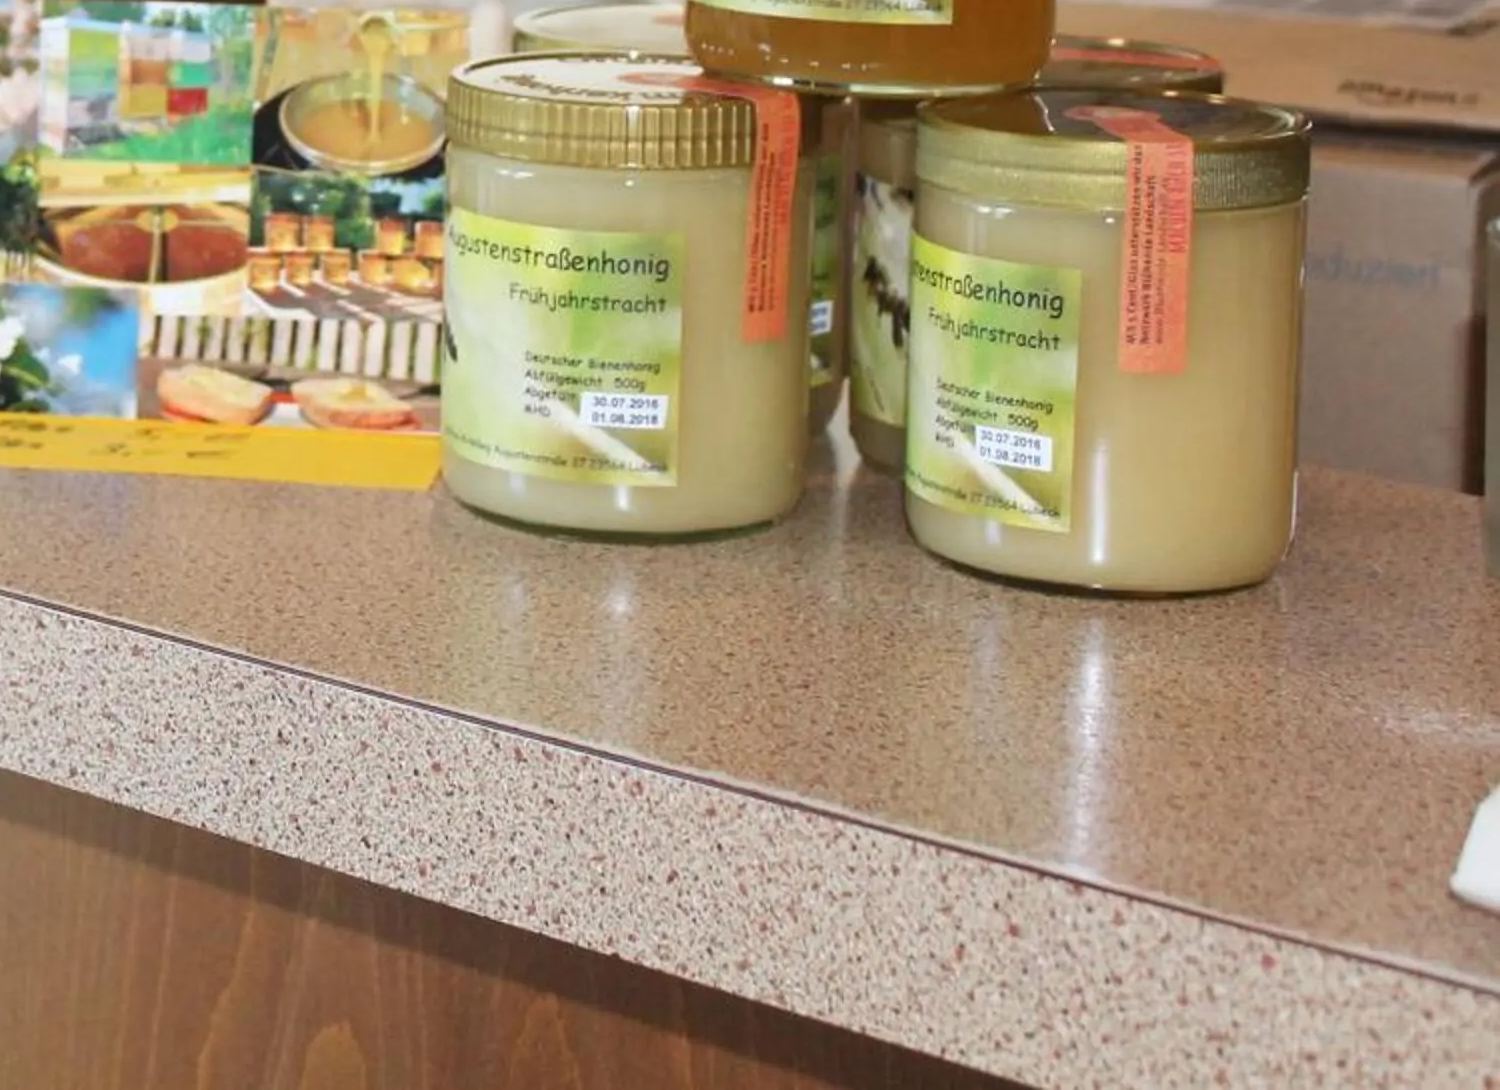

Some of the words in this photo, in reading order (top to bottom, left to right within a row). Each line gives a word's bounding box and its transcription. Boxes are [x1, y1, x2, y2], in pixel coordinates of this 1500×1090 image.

[448, 225, 671, 282] Augustenstraßenhonig
[508, 282, 668, 314] Frühjahrstracht
[928, 306, 1061, 351] Frühjahrstracht
[614, 377, 646, 392] 500g
[1007, 413, 1039, 432] 500g
